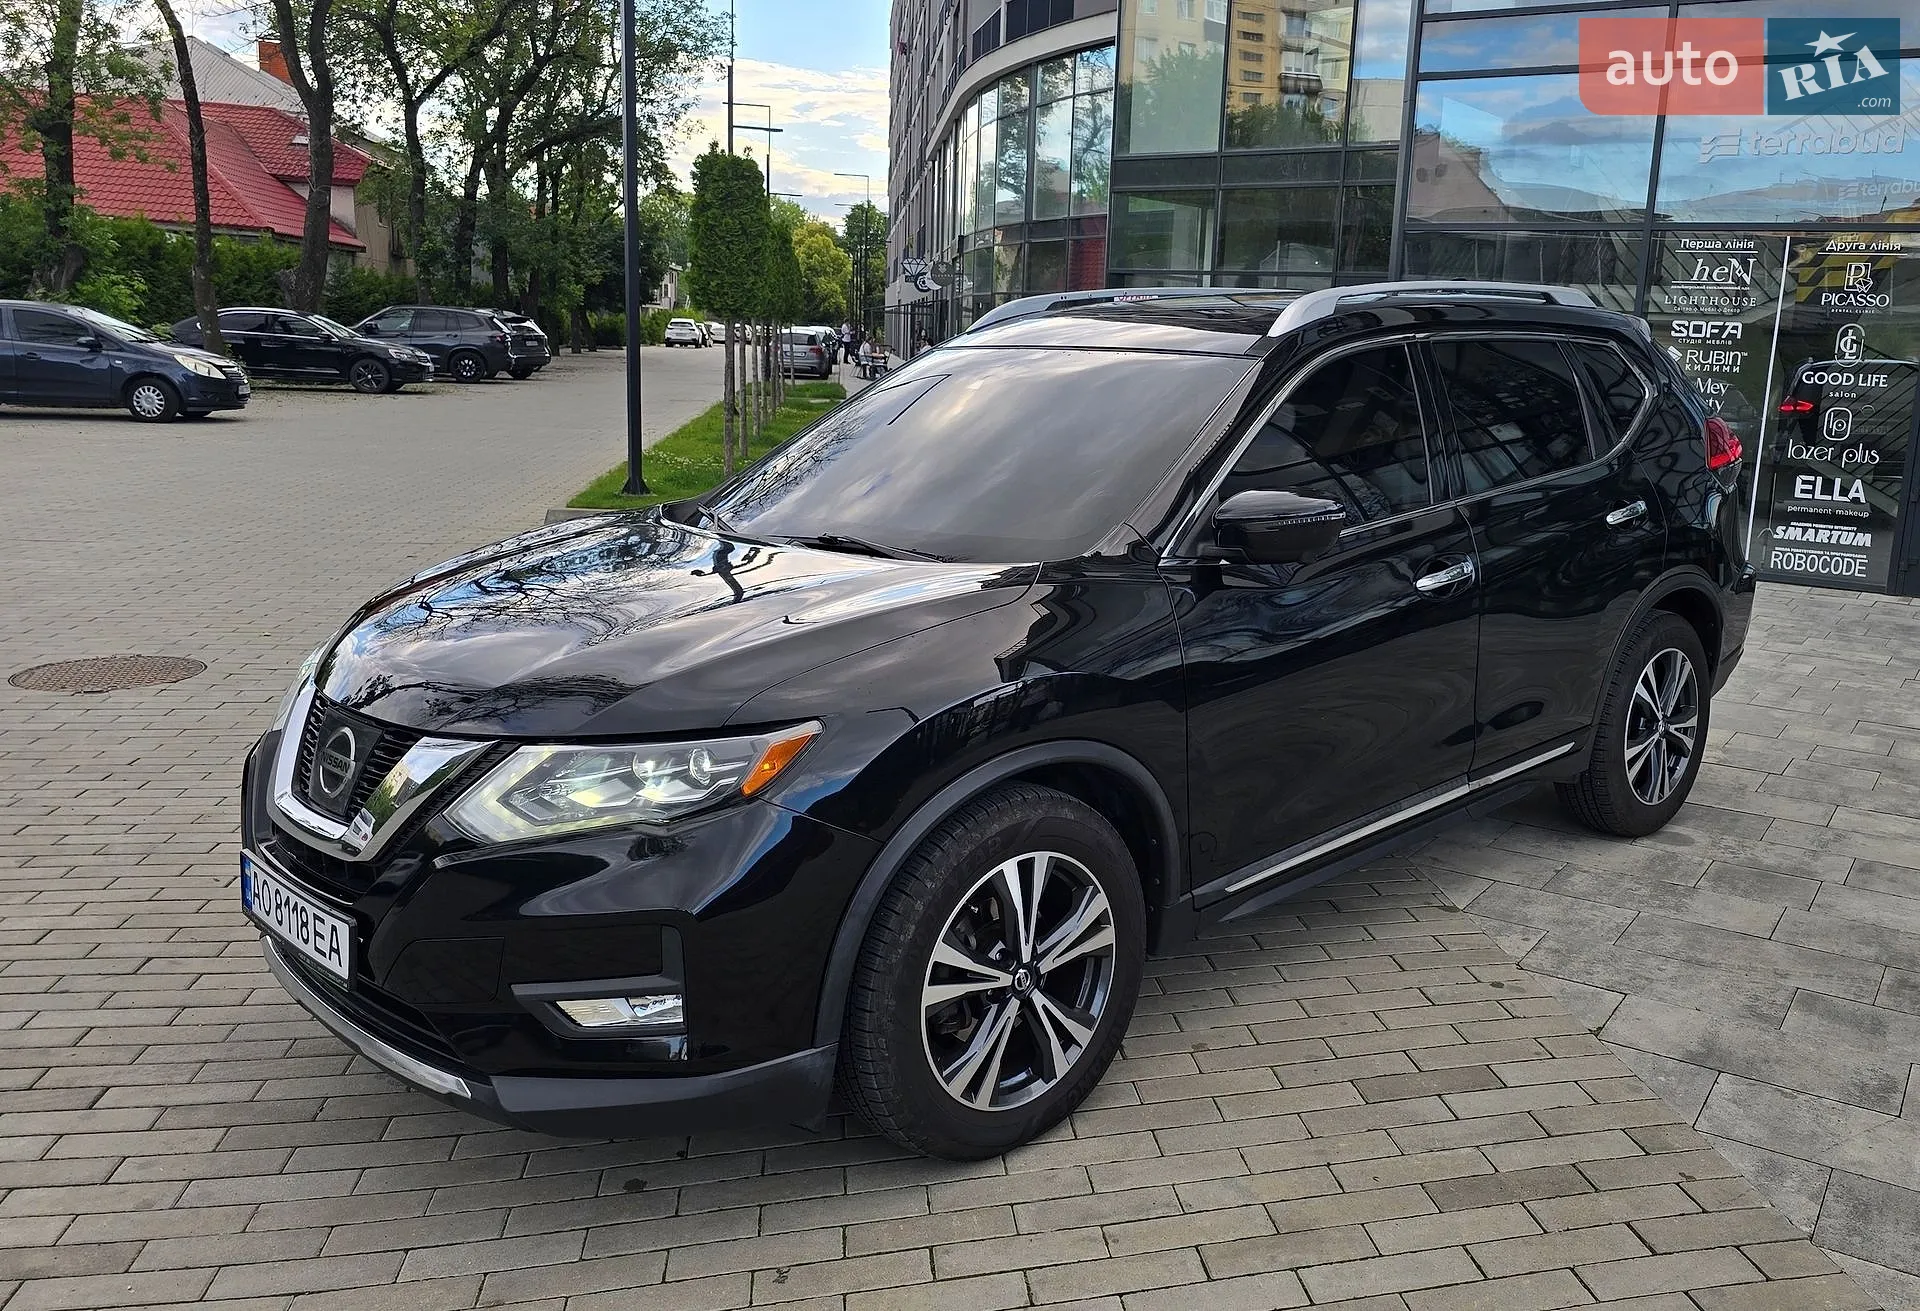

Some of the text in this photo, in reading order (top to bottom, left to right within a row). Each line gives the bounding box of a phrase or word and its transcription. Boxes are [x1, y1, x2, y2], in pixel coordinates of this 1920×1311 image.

[1752, 124, 1906, 156] terrabud
[1681, 238, 1754, 250] Перша лінія
[1826, 240, 1901, 252] Друга лінія
[1664, 295, 1757, 307] LIGHTHOUSE
[1821, 293, 1890, 307] PICASSO
[1670, 320, 1743, 339] SOFA
[1685, 363, 1740, 373] КИЛИМИ
[1802, 371, 1888, 387] GOOD LIFE
[1829, 390, 1857, 398] salon
[1787, 438, 1880, 468] lazer plus
[1794, 474, 1866, 503] ELLA
[1787, 504, 1870, 518] permanent makeup
[1773, 525, 1872, 547] SMARTUM
[1770, 551, 1868, 577] ROBOCODE
